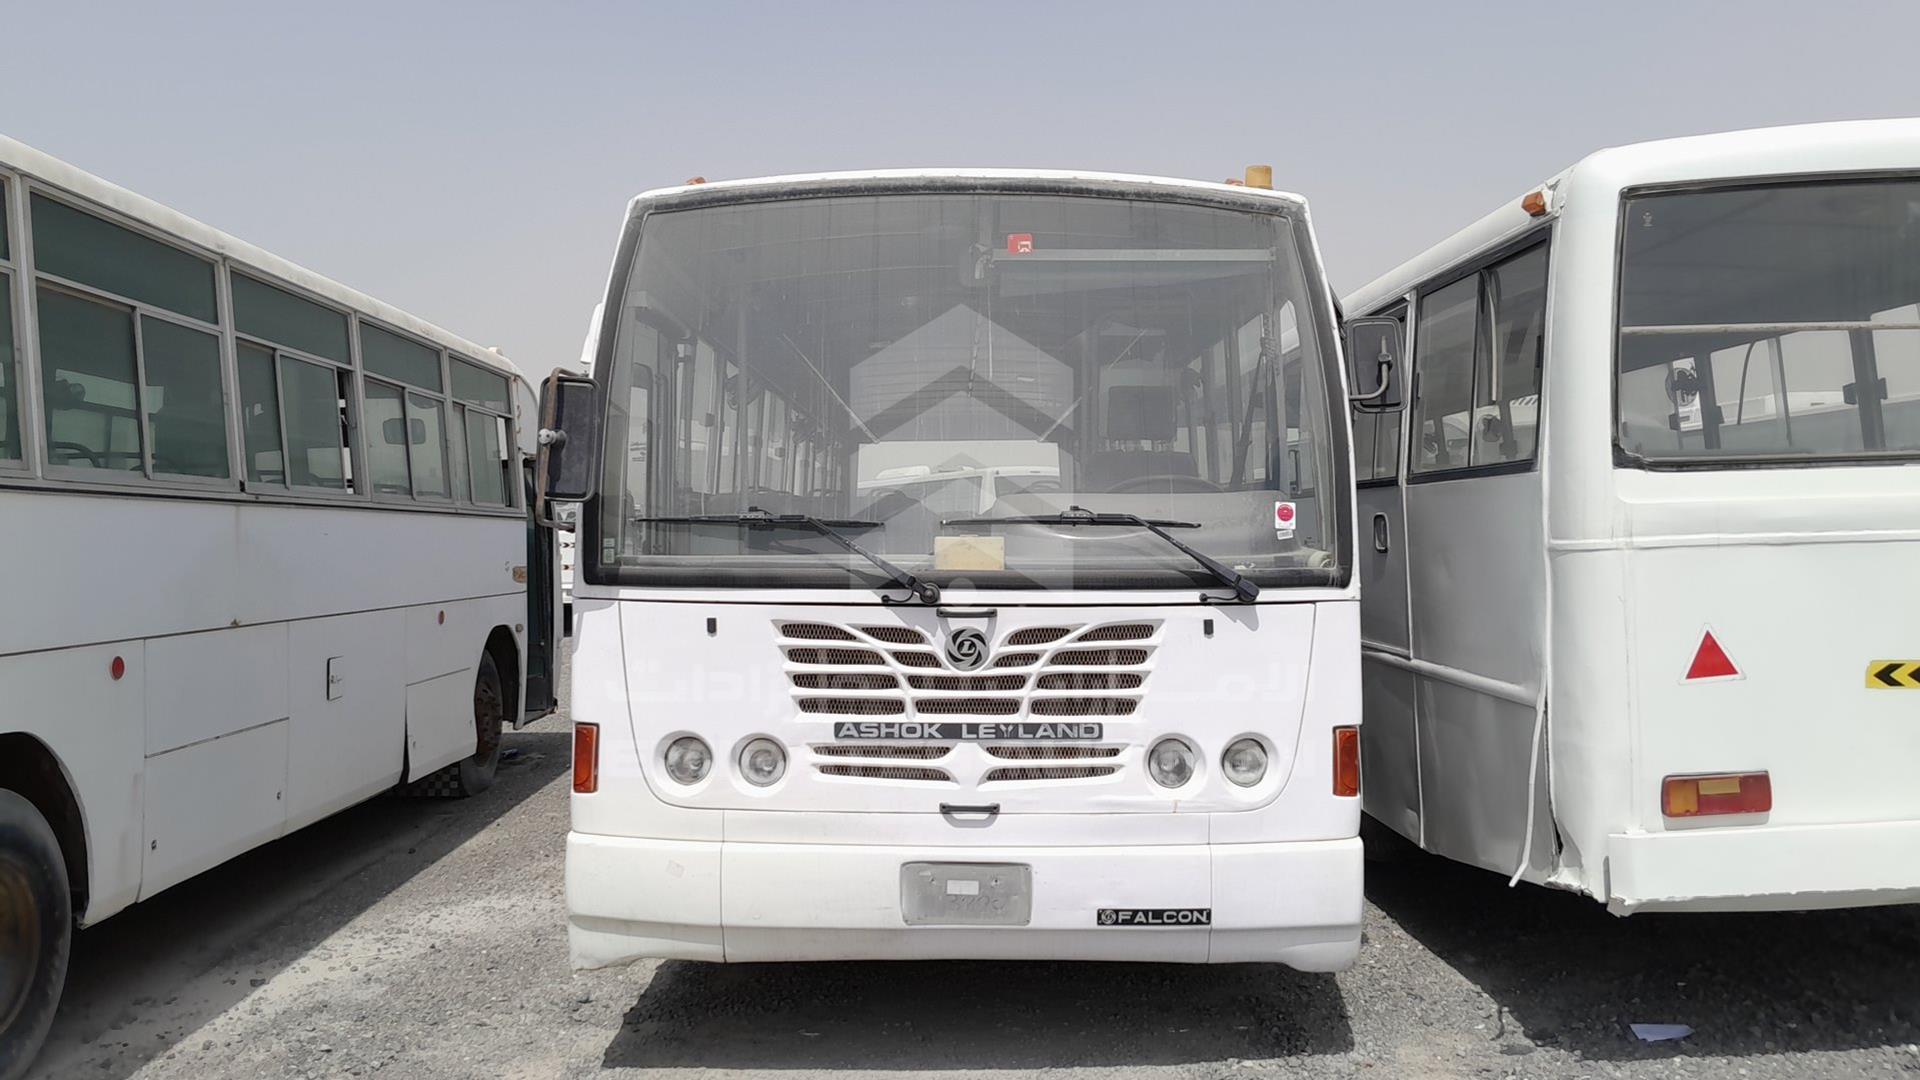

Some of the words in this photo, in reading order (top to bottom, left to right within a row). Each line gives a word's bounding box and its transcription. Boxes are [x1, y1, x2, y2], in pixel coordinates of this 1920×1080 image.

[838, 722, 943, 739] ASHOK
[961, 722, 1100, 739] LEYLAND
[1118, 911, 1209, 923] FALCON
